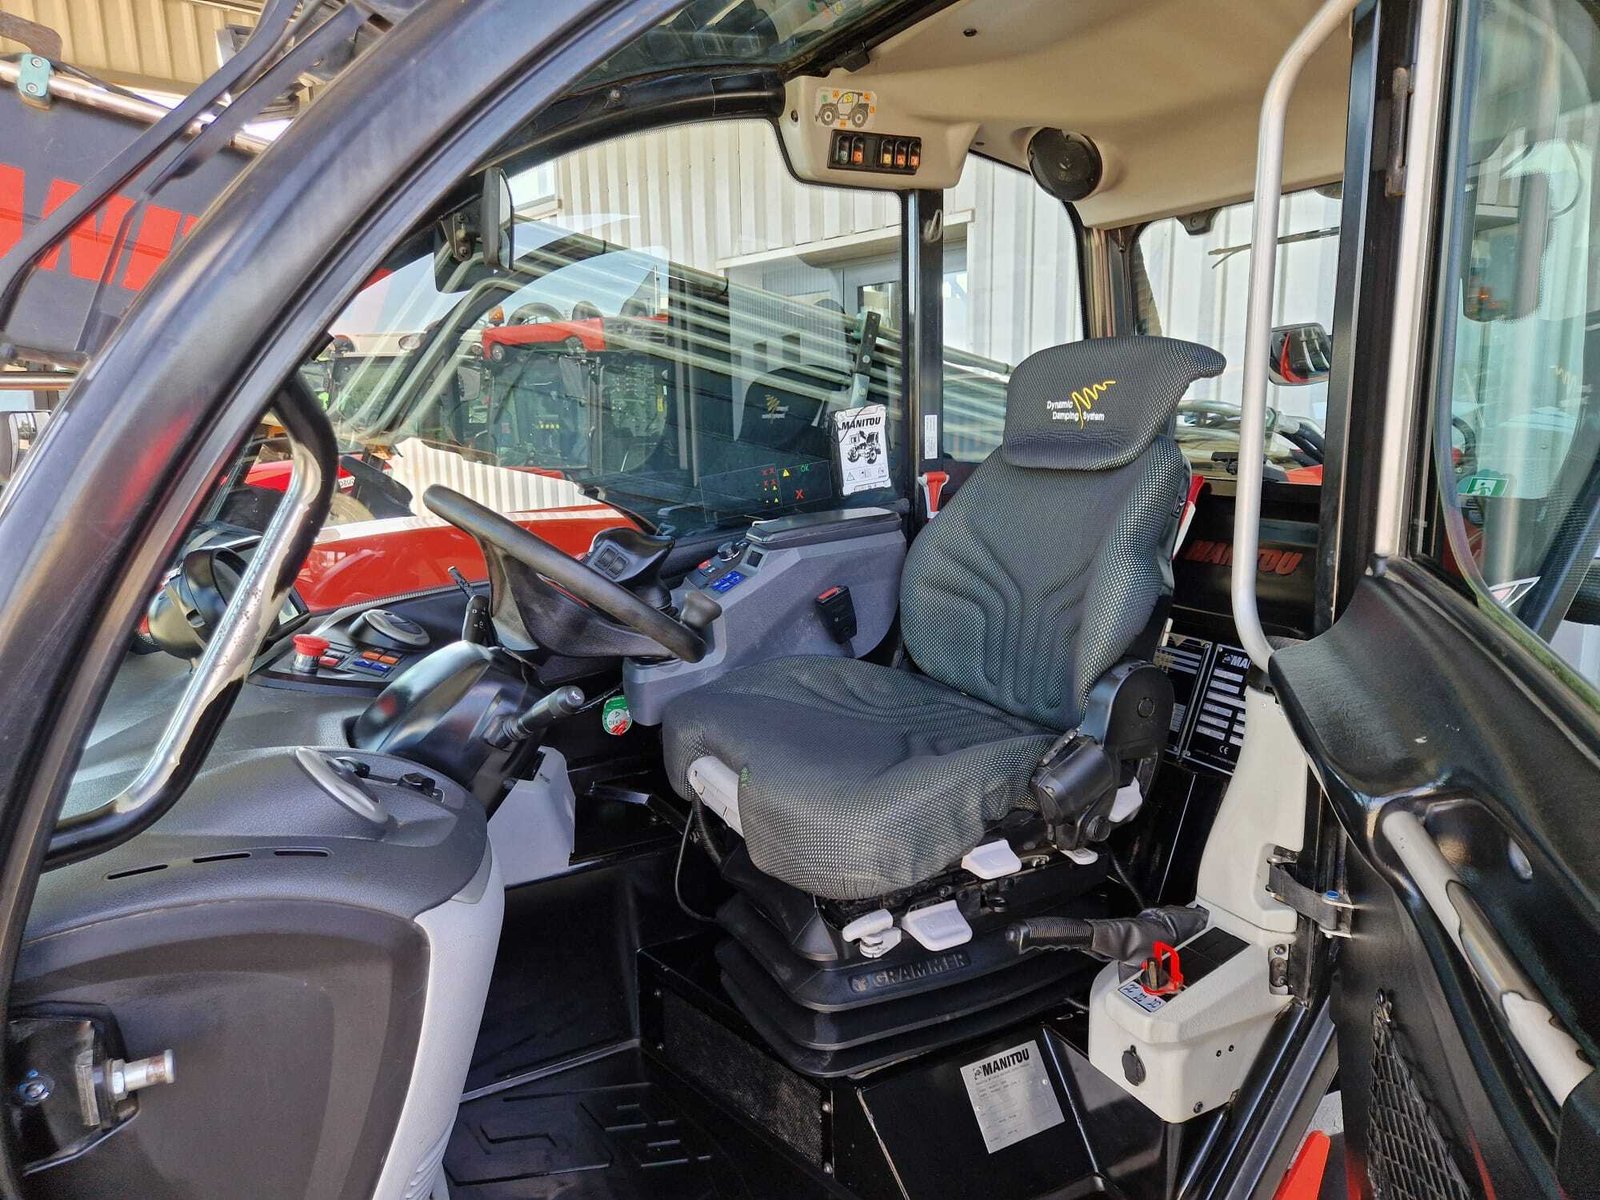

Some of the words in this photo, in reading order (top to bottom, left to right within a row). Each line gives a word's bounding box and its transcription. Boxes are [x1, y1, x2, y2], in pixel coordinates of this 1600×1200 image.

[1046, 400, 1074, 411] Dynamic
[841, 416, 881, 431] MANITOU
[1052, 411, 1080, 422] Damping
[1082, 411, 1105, 422] System
[874, 953, 966, 986] GRAMMER
[981, 1048, 1030, 1077] MANITOU
